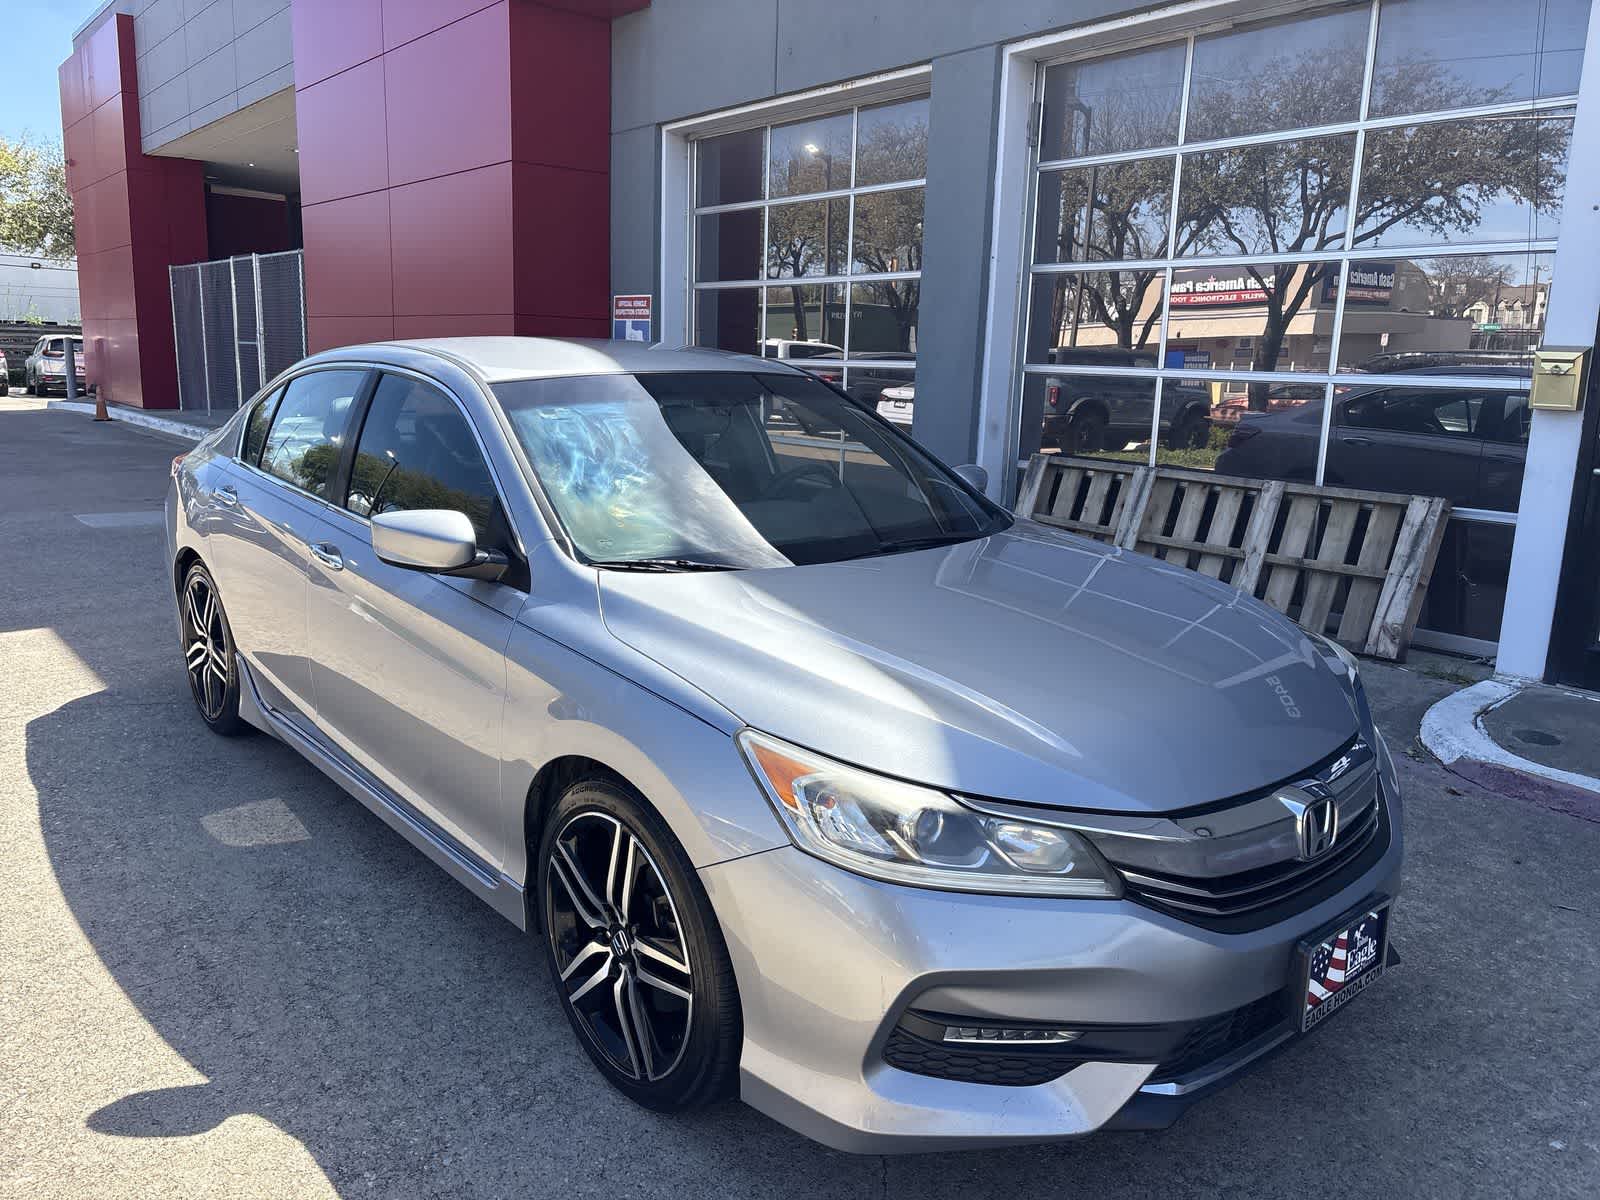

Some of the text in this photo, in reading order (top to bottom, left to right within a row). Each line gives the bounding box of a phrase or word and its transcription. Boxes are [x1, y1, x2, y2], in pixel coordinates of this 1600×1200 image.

[1346, 938, 1377, 972] Eagle
[1304, 999, 1333, 1029] EAGLE
[1334, 965, 1383, 1007] HONDA.COM
